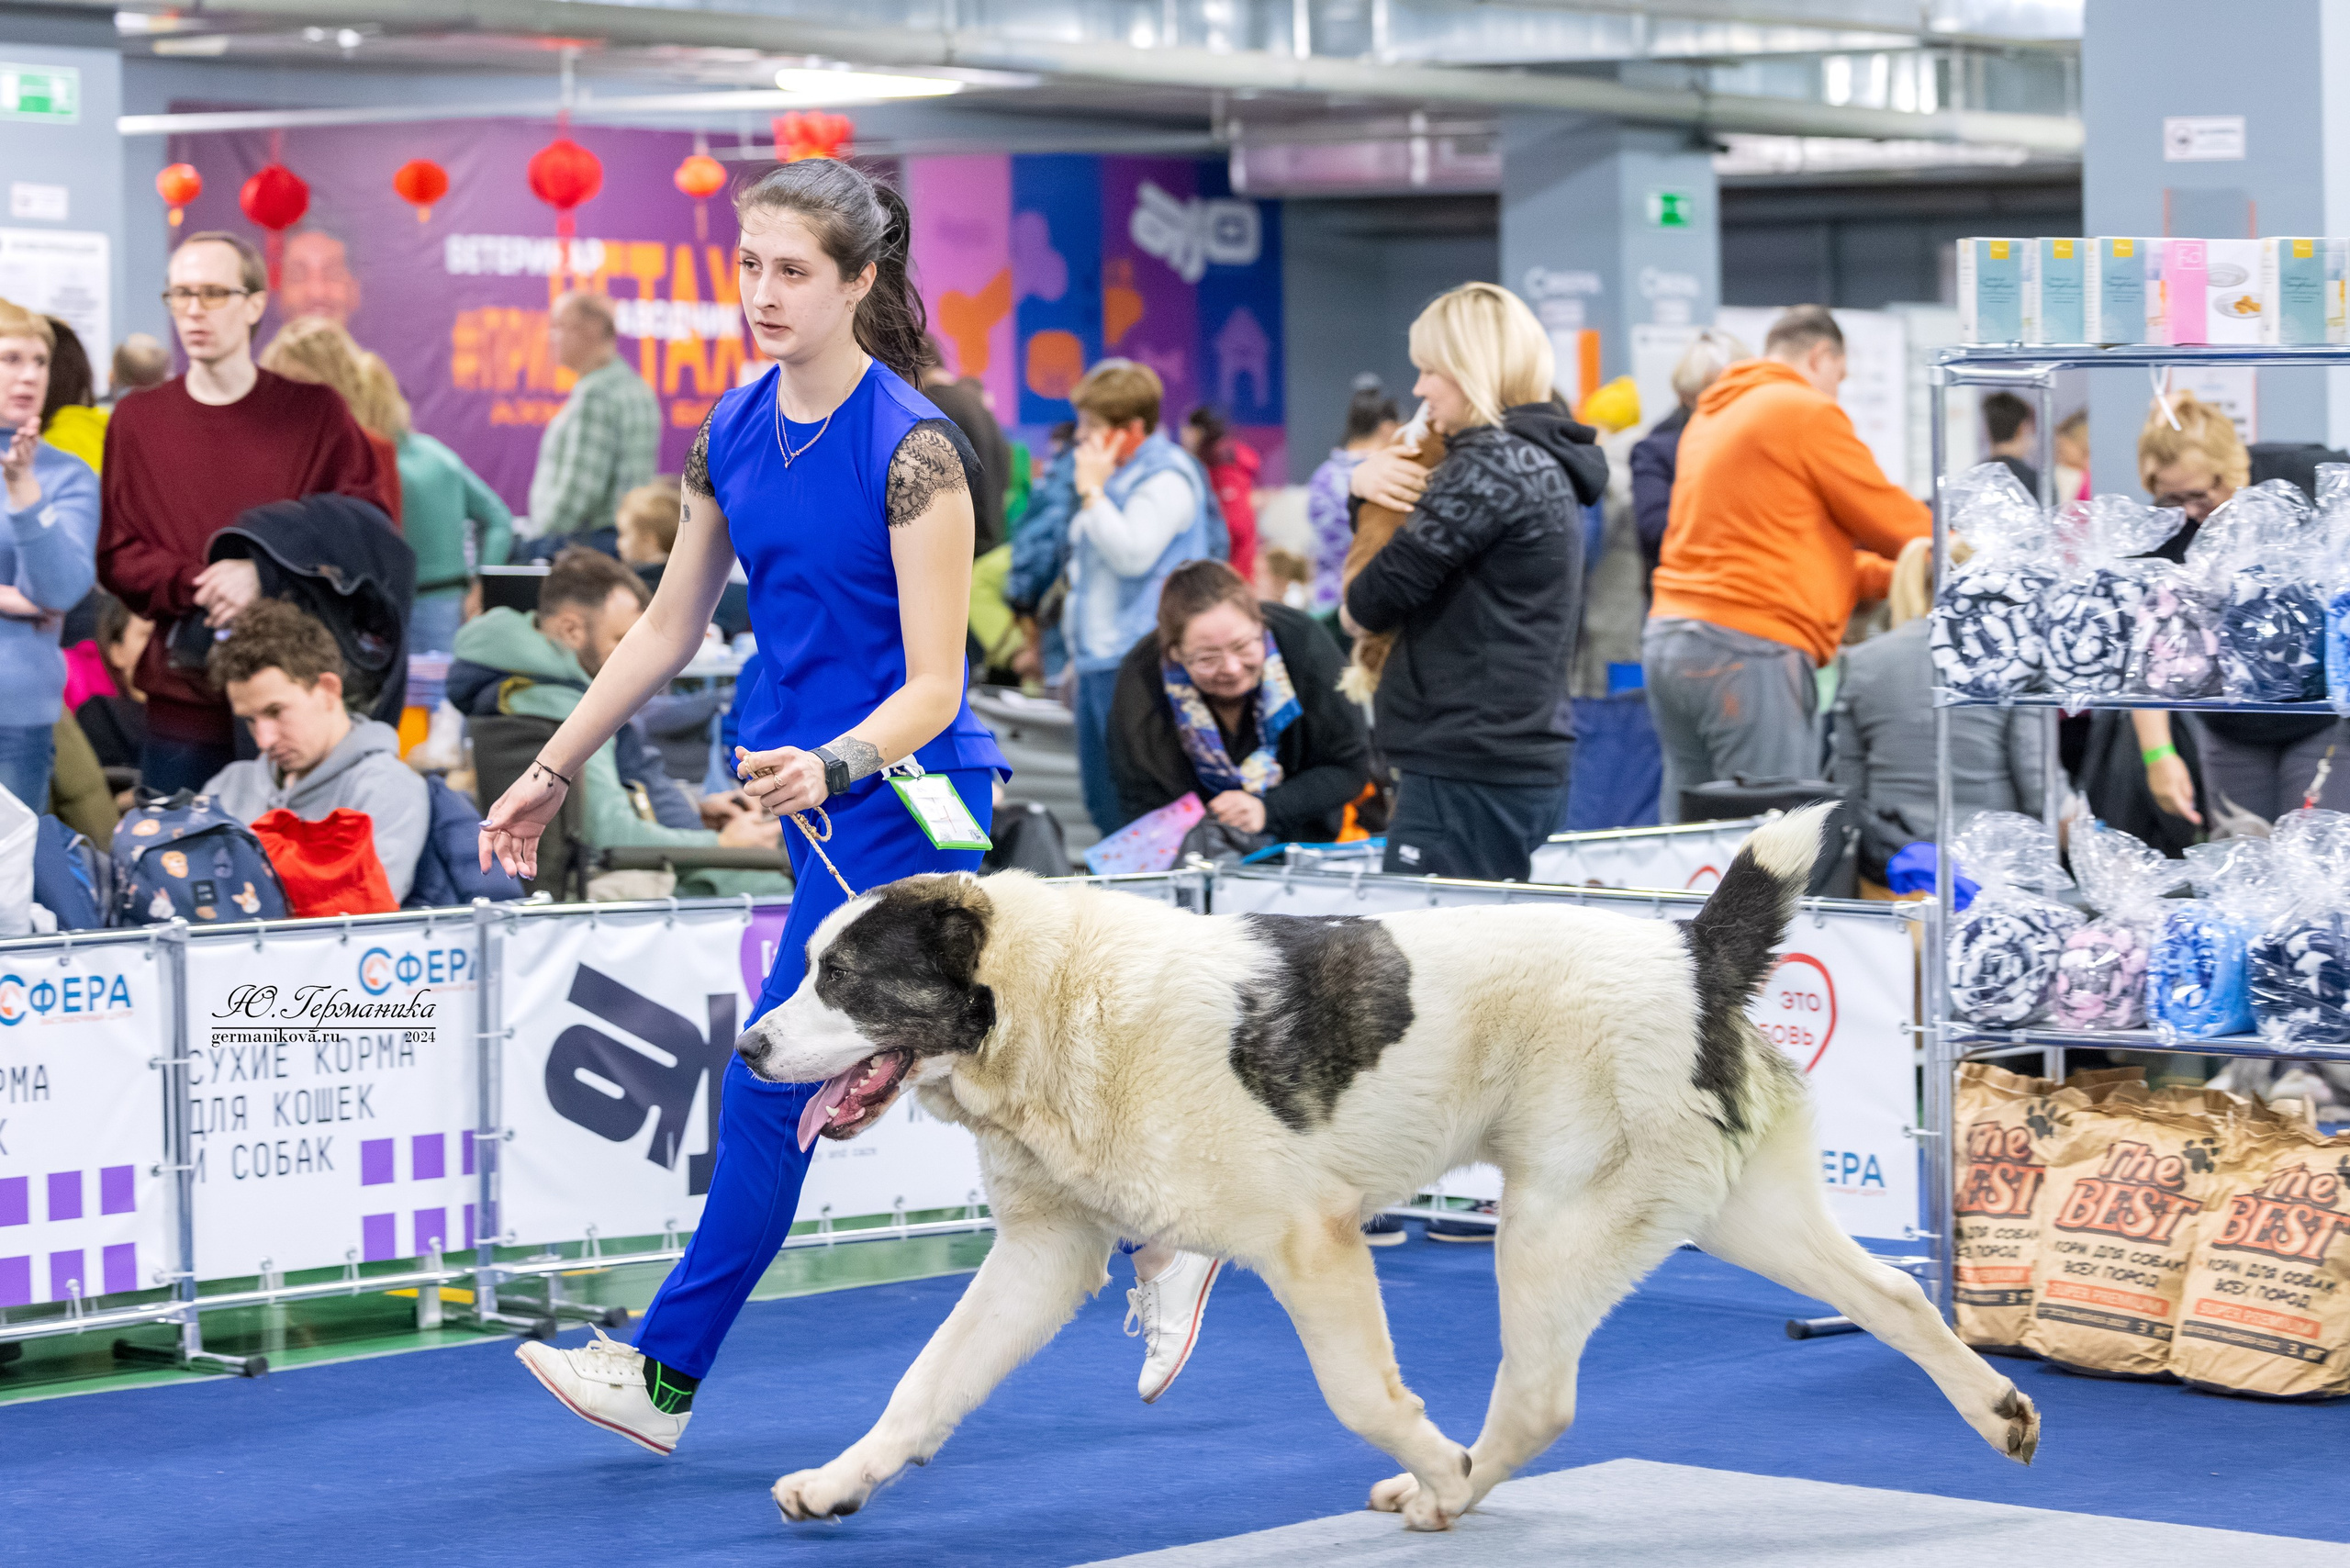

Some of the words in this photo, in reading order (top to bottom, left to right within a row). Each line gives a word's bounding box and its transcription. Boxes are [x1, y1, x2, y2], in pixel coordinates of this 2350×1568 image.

[445, 233, 606, 275] ВЕТЕРИАР
[358, 946, 479, 996] СФЕР
[0, 974, 132, 1026] СФЕРА
[1781, 991, 1821, 1012] ЭТО
[188, 1042, 289, 1085] СУХИЕ
[315, 1034, 416, 1075] КОРМА
[190, 1095, 248, 1141] ДЛЯ
[274, 1083, 375, 1127] КОШЕК
[232, 1136, 335, 1180] СОБАК
[2098, 1139, 2186, 1193] The
[1954, 1160, 2046, 1219] EST
[2054, 1178, 2203, 1247] BEST
[2210, 1193, 2350, 1267] BEST
